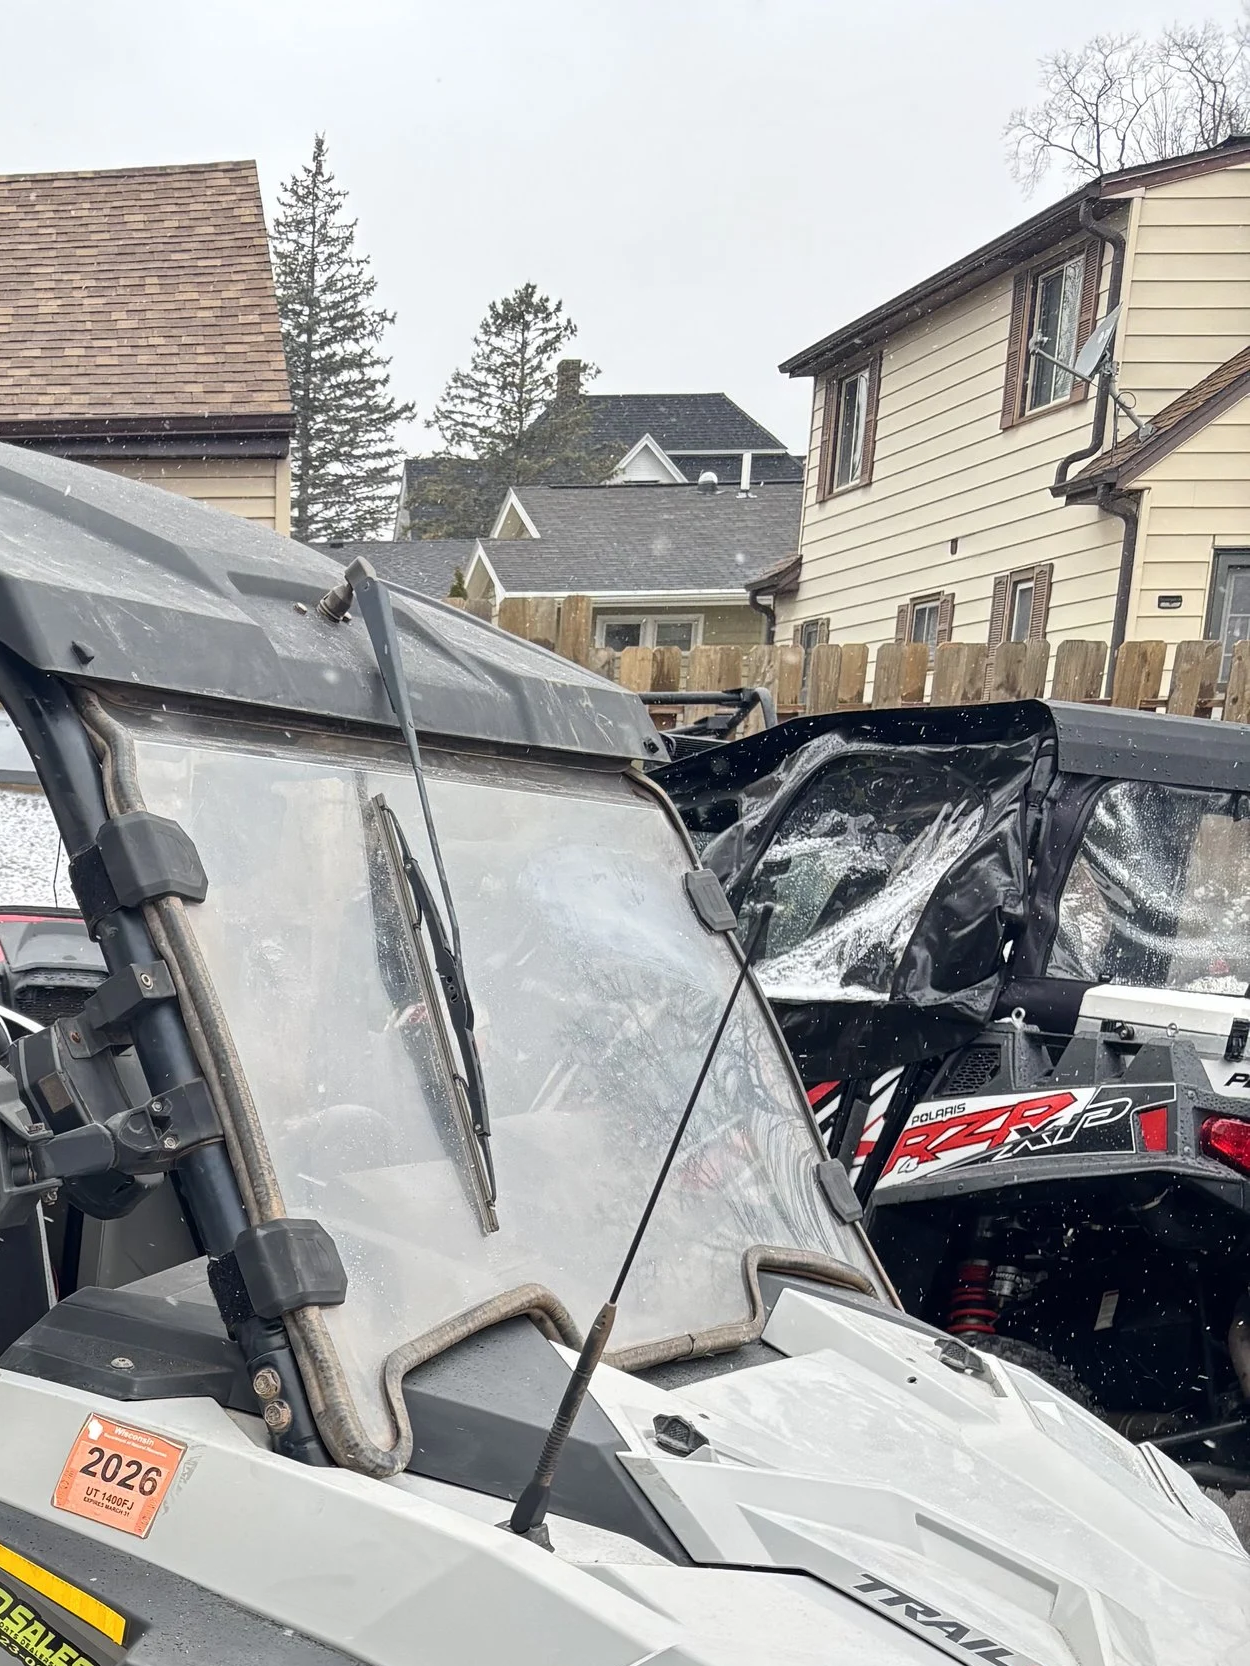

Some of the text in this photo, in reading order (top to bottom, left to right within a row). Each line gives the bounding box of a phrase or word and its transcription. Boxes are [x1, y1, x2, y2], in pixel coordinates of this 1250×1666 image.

[911, 1103, 966, 1126] POLARIS
[879, 1091, 1133, 1177] RZR XP
[898, 1156, 919, 1174] 4
[114, 1426, 155, 1446] Wisconsin
[79, 1446, 162, 1497] 2026
[83, 1496, 104, 1508] EXPIRES
[105, 1504, 123, 1516] MARCH
[85, 1486, 135, 1511] UT 1400FJ
